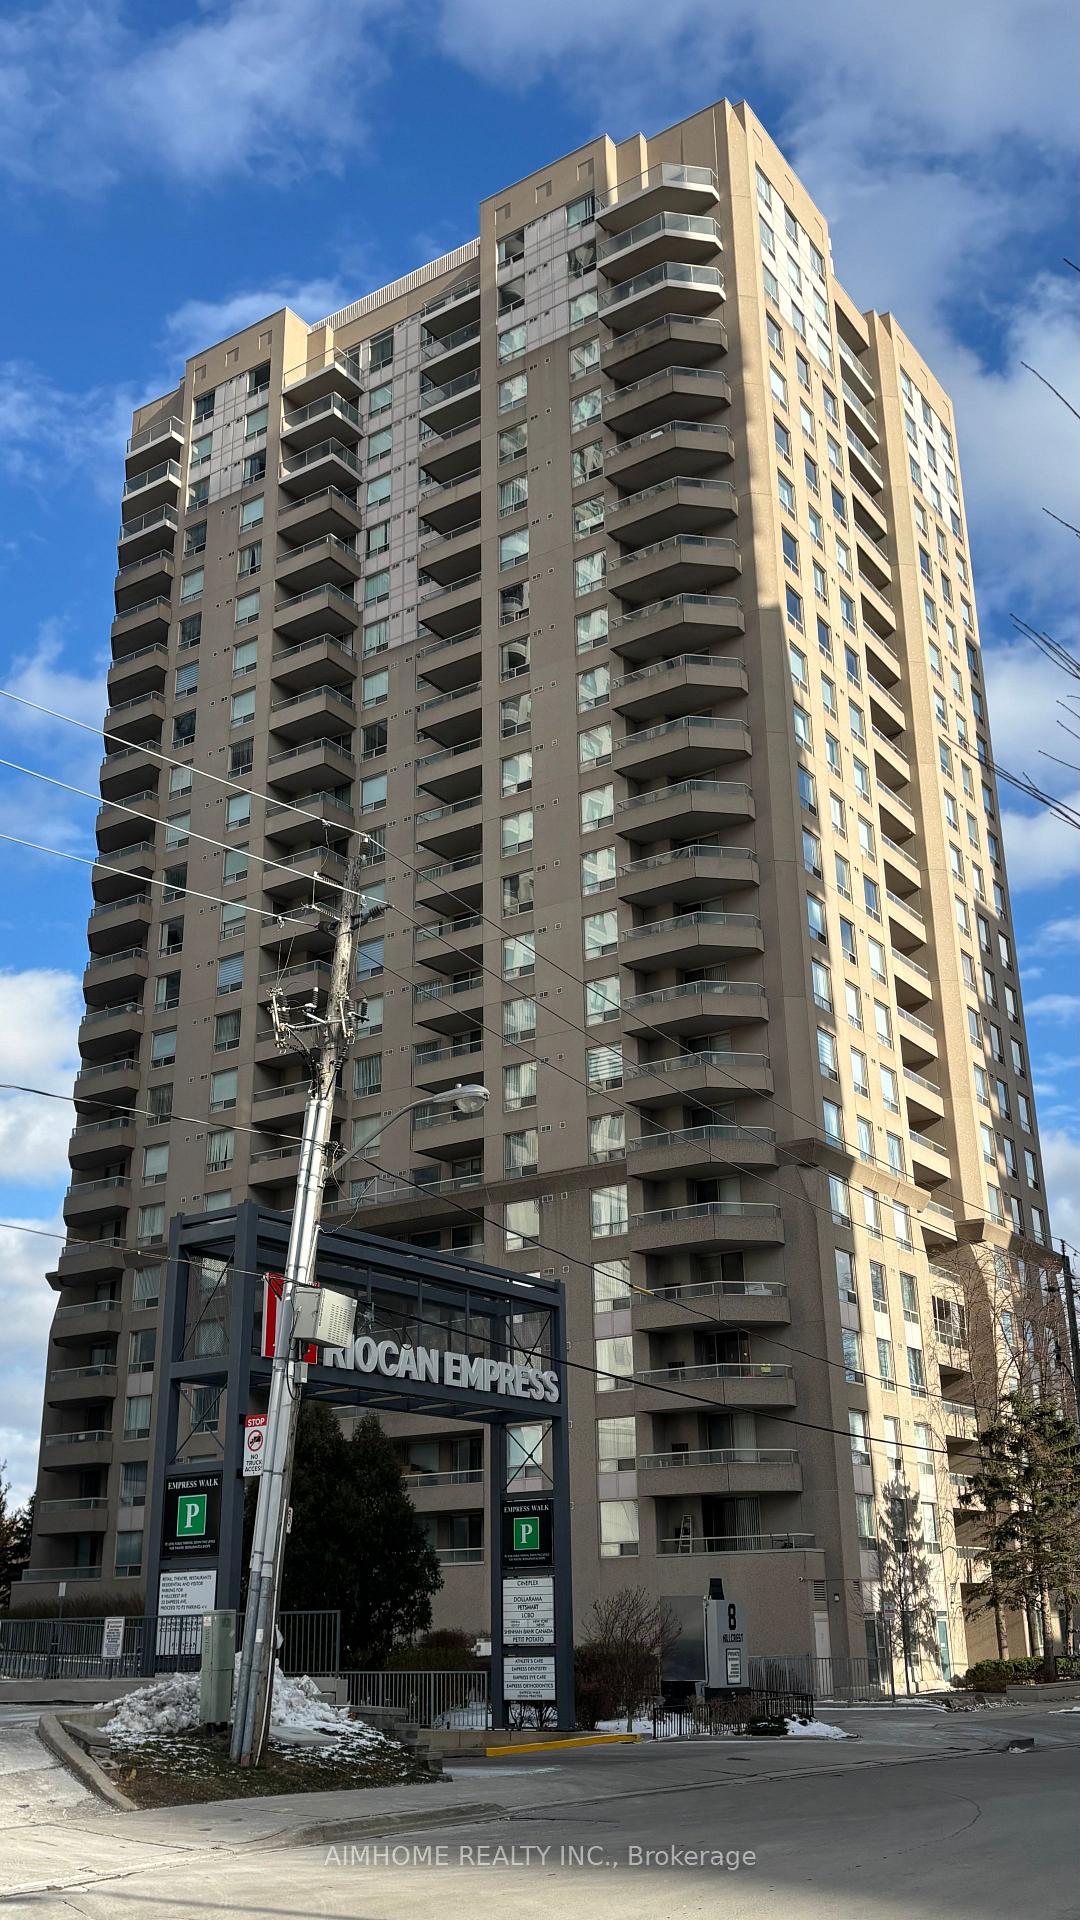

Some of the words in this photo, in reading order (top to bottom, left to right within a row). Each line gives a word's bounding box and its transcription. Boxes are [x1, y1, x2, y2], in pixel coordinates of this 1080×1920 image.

[323, 1334, 439, 1383] RIOCAN
[444, 1351, 560, 1403] EMPRESS
[247, 1417, 265, 1427] STOP
[168, 1480, 198, 1490] EMPRESS
[198, 1478, 219, 1487] WALK
[184, 1503, 200, 1528] P
[503, 1505, 530, 1513] EMPRESS
[520, 1523, 533, 1544] P
[728, 1603, 737, 1631] 8
[722, 1633, 744, 1643] HILLCREST
